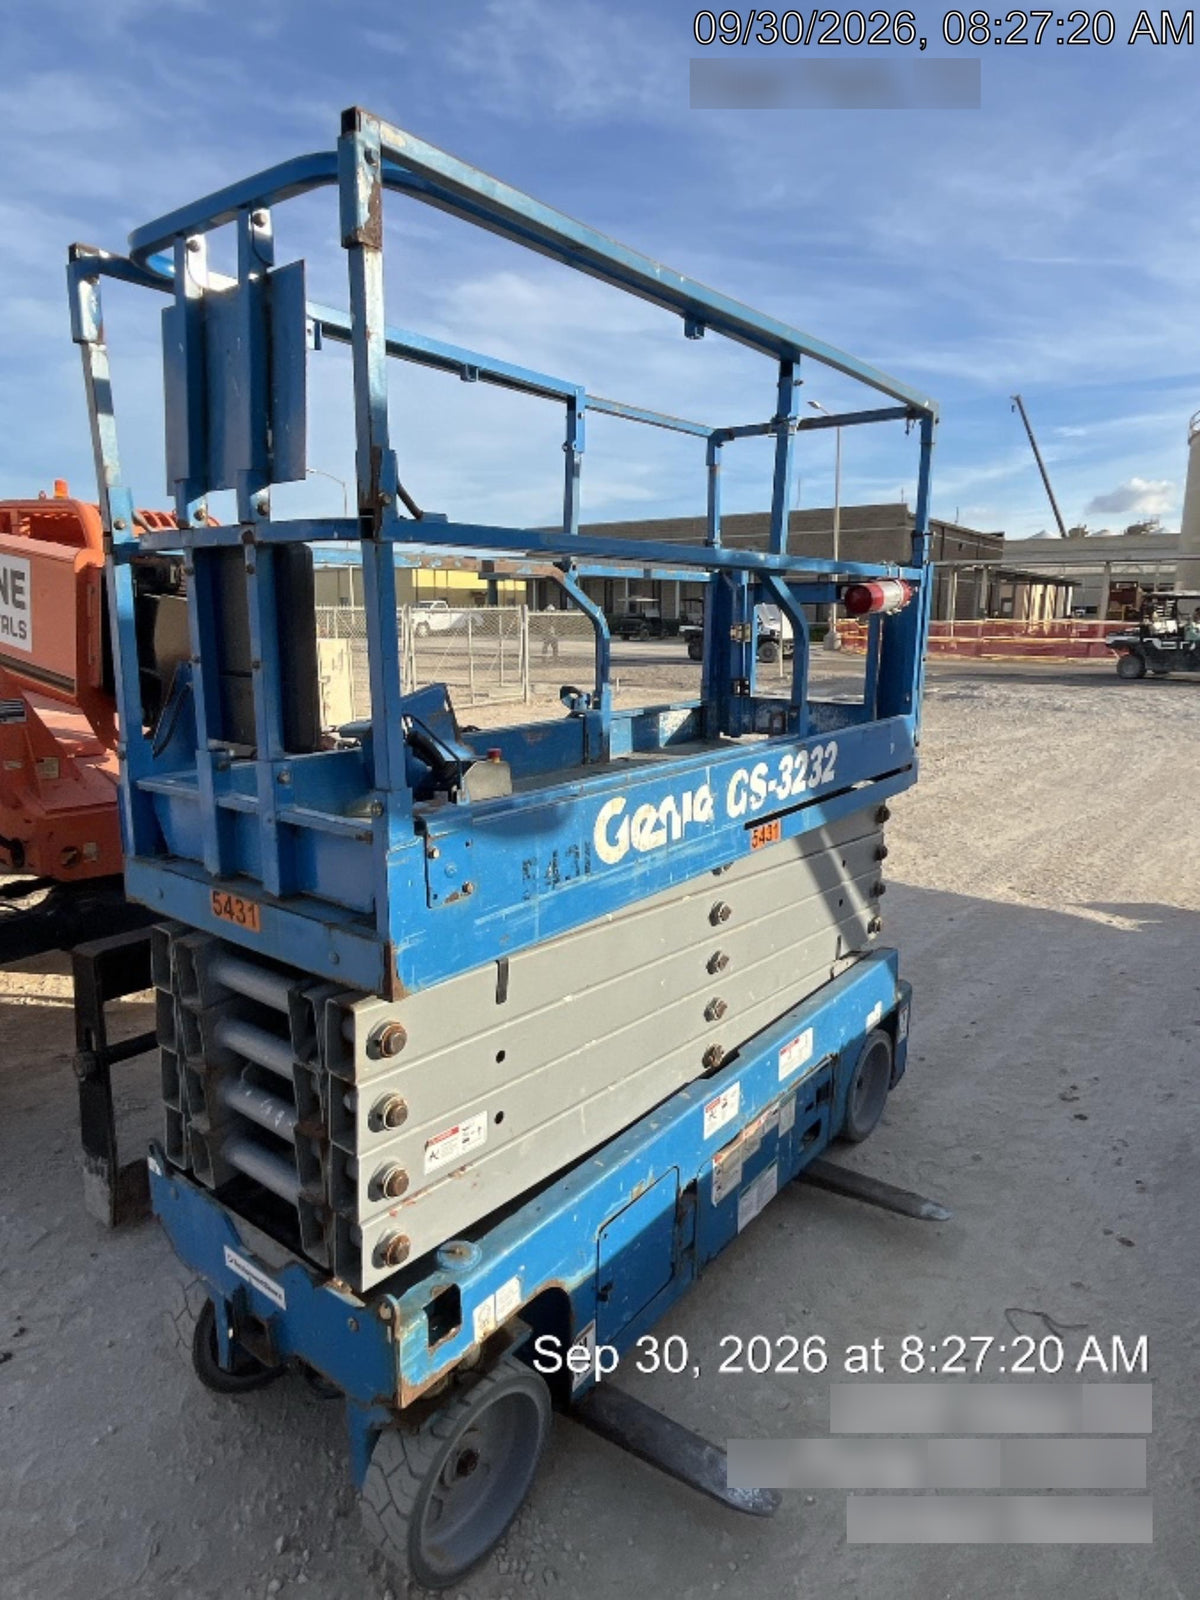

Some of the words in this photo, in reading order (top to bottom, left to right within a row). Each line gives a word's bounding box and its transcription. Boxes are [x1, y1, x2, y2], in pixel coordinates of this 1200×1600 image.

[593, 784, 715, 865] Genie
[726, 741, 839, 819] GS-3232
[752, 822, 779, 849] 5431
[212, 890, 257, 929] 5431
